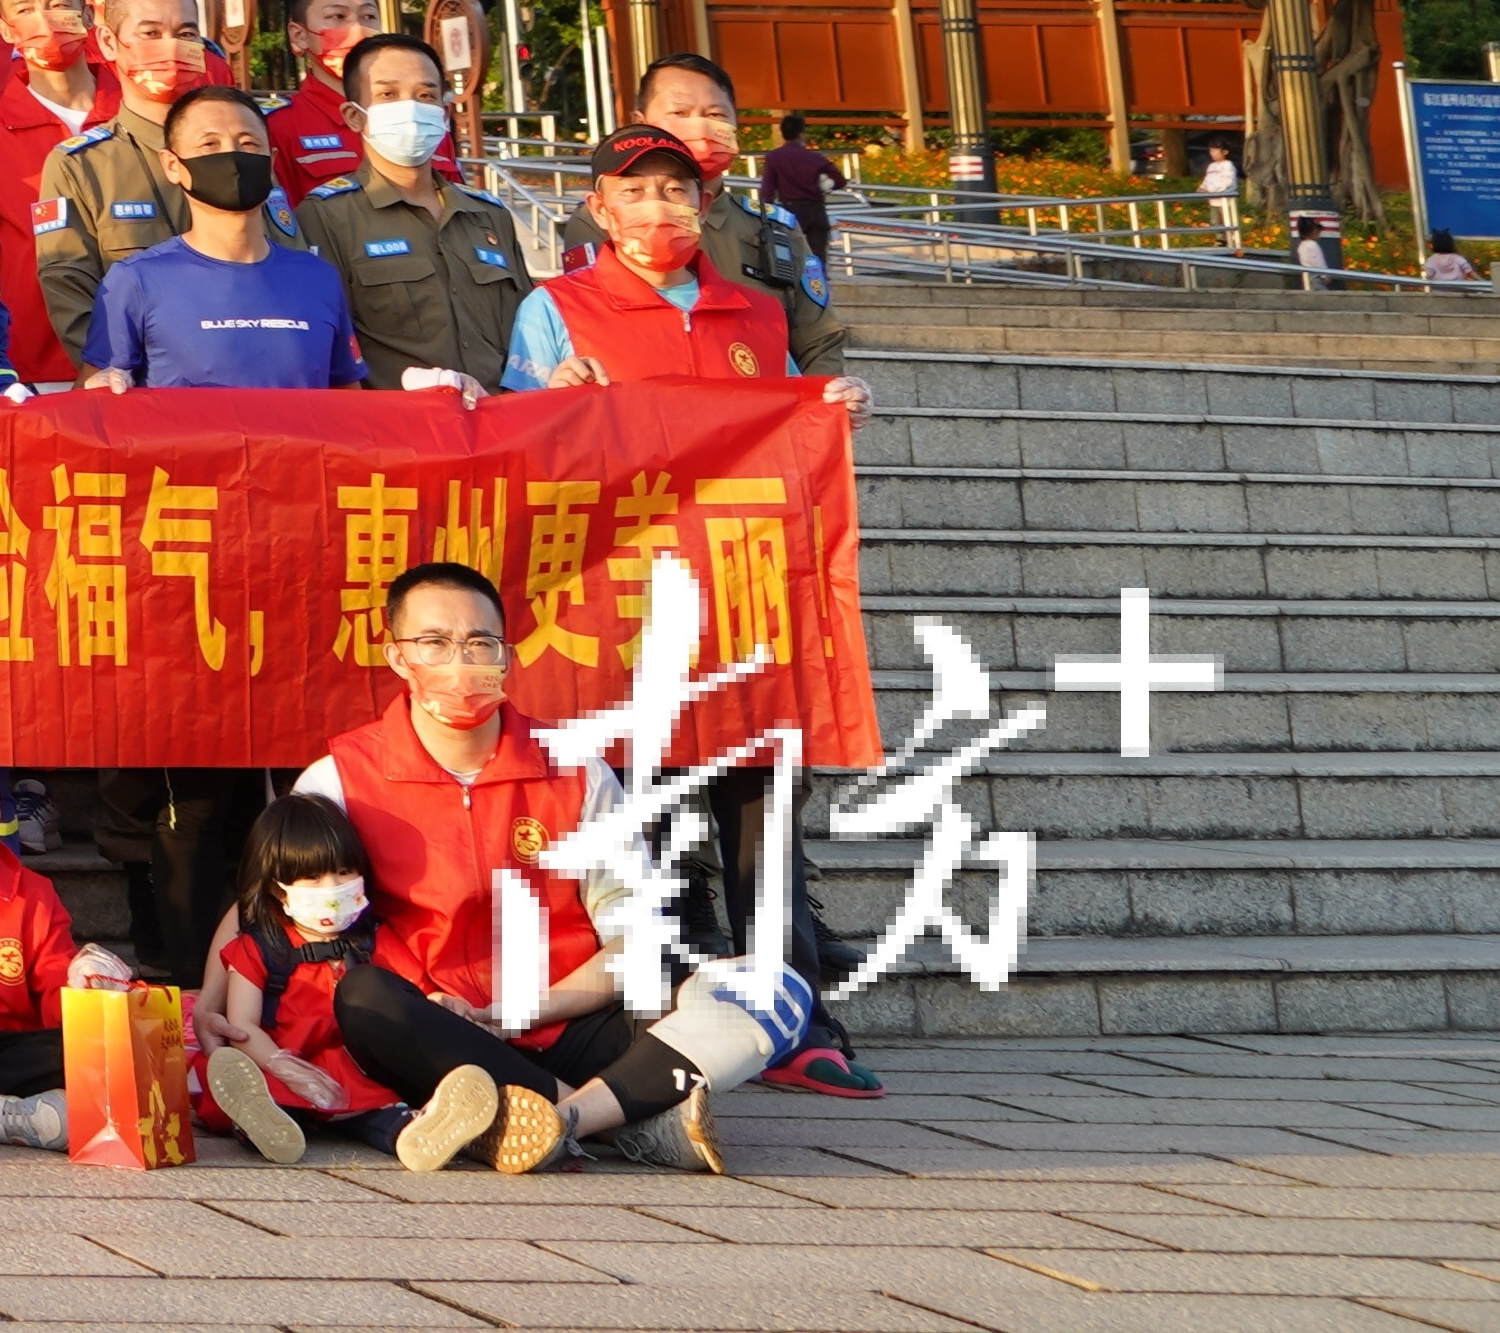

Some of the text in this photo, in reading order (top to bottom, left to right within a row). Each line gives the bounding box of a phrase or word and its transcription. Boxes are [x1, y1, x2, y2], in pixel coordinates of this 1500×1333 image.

[201, 319, 309, 331] BLUE SKY RESCUE
